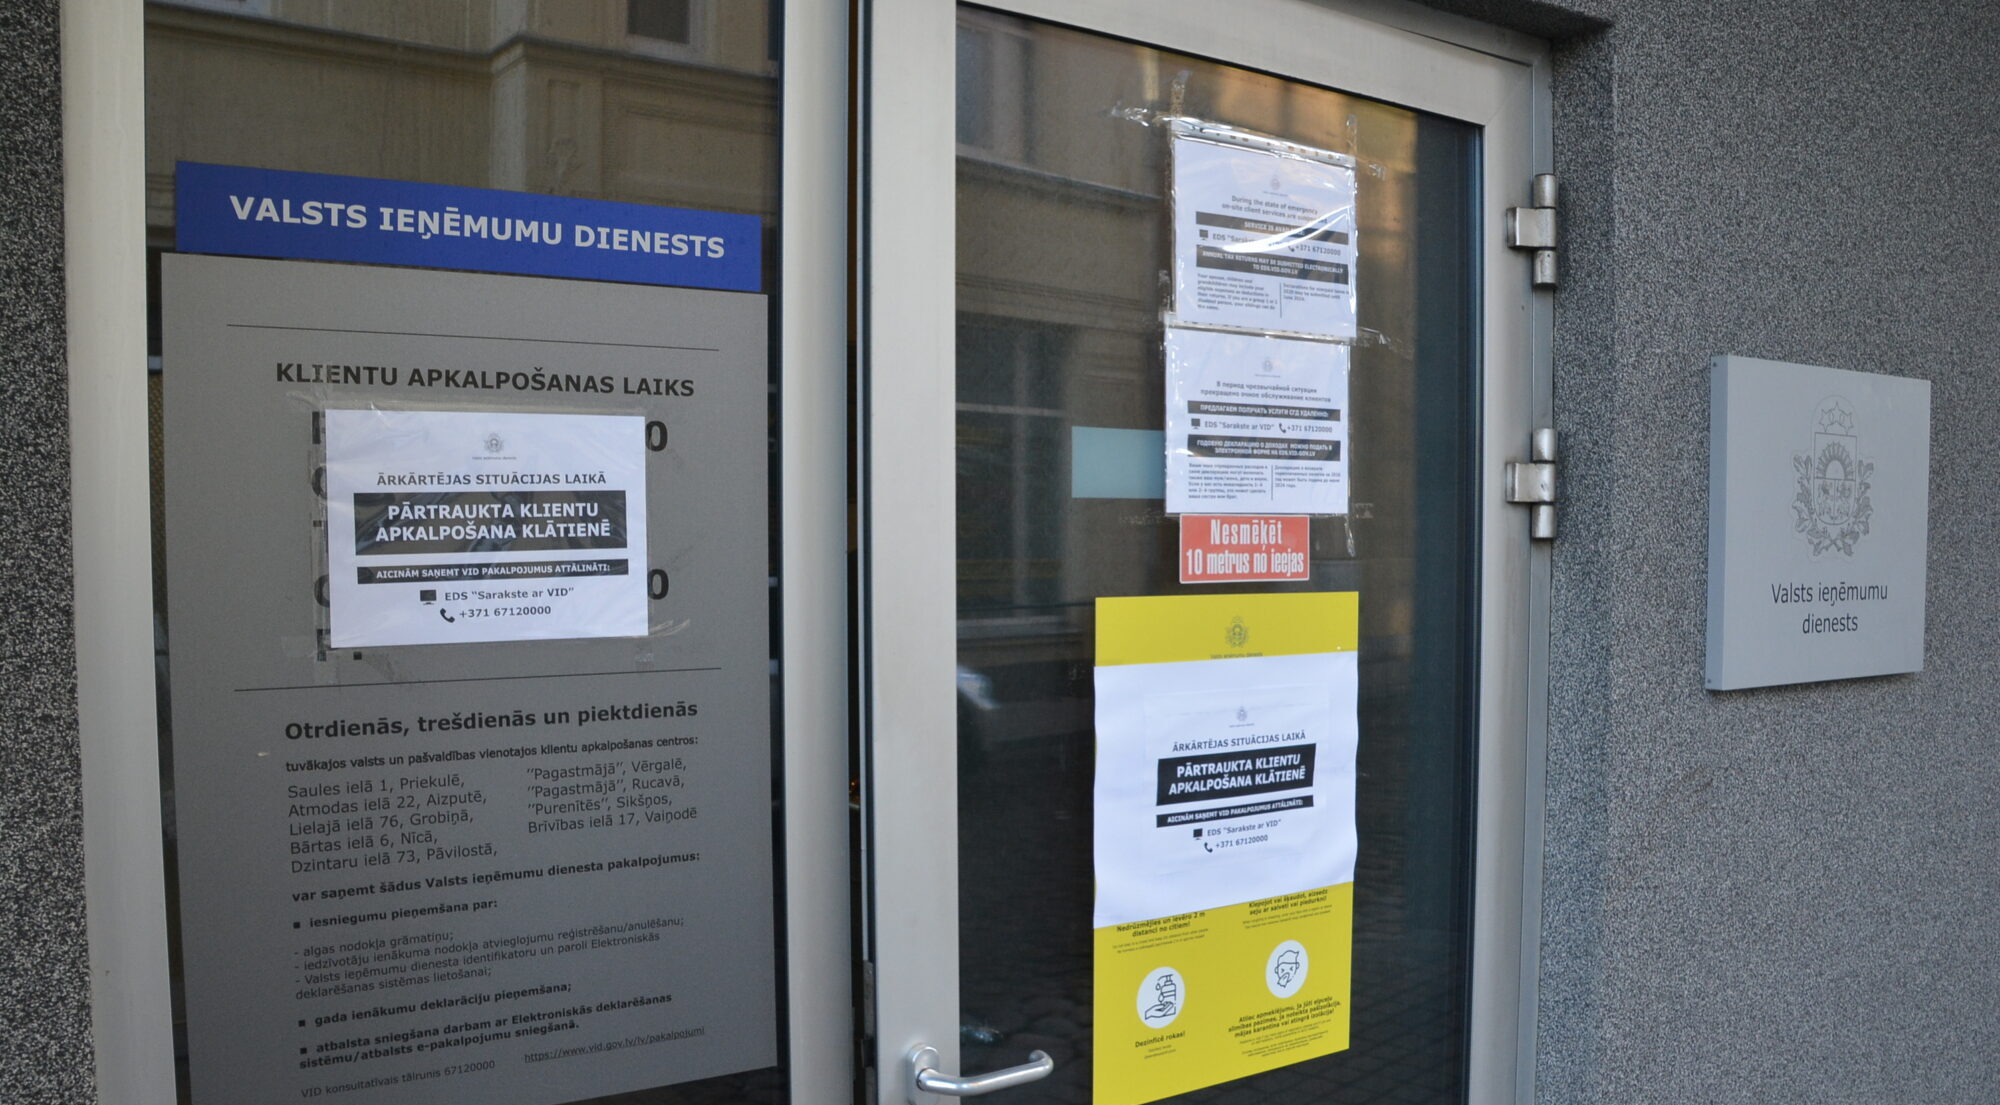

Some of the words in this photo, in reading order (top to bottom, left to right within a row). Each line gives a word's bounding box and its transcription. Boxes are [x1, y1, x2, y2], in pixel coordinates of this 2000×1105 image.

[230, 196, 367, 228] VALSTS
[380, 207, 562, 245] IEŅĒMUMU
[575, 225, 725, 258] DIENESTS
[277, 363, 397, 386] KLIENTU
[408, 367, 614, 393] APKALPOŠANAS
[624, 377, 694, 396] LAIKS
[377, 472, 471, 486] ĀRKĀRTĒJAS
[476, 471, 560, 485] SITUĀCIJAS
[565, 471, 606, 484] LAIKĀ
[388, 502, 514, 520] PĀRTRAUKTA
[520, 503, 598, 517] KLIENTU
[376, 521, 517, 542] APKALPOŠANA
[522, 519, 610, 538] KLĀTIENĒ
[1211, 519, 1282, 550] Nesmēķēt
[376, 568, 419, 578] AICINĀM
[422, 569, 460, 578] SAŅEMT
[462, 568, 479, 576] VID
[482, 565, 552, 575] PAKALPOJUMUS
[555, 563, 610, 573] ATTĀLINĀTI:
[1186, 548, 1203, 575] 10
[1207, 550, 1249, 574] metrus
[1254, 552, 1267, 574] no
[1271, 548, 1304, 577] ieejas
[445, 592, 468, 601] EDS
[532, 590, 543, 598] ar
[1771, 583, 1813, 603] Valsts
[1818, 581, 1888, 607] ieņēmumu
[459, 608, 489, 618] +371
[494, 605, 551, 616] 67120000
[1802, 613, 1858, 634] dienests
[285, 717, 410, 740] Otrdienās,
[418, 710, 536, 732] trešdienās
[544, 711, 570, 724] un
[578, 701, 698, 726] piektdienās
[286, 758, 346, 772] tuvākajos
[350, 755, 385, 767] valsts
[389, 756, 404, 765] un
[408, 751, 475, 767] pašvaldības
[479, 745, 537, 759] vienotajos
[541, 742, 578, 754] klientu
[581, 738, 653, 753] apkalpošanas
[656, 736, 698, 747] centros:
[1172, 737, 1228, 752] ĀRKĀRTĒJAS
[1231, 733, 1279, 747] SITUĀCIJAS
[1282, 730, 1306, 742] LAIKĀ
[631, 758, 687, 774] Vērgalē,
[1177, 759, 1253, 778] PĀRTRAUKTA
[1256, 754, 1300, 768] KLIENTU
[288, 784, 340, 798] Saules
[346, 781, 373, 794] ielā
[380, 779, 393, 793] 1,
[400, 774, 465, 790] Priekulē,
[632, 777, 685, 791] Rucavā,
[1169, 774, 1252, 795] APKALPOŠANA
[1255, 765, 1305, 785] KLĀTIENĒ
[288, 800, 358, 817] Atmodas
[364, 797, 390, 811] ielā
[397, 796, 420, 810] 22,
[426, 790, 487, 808] Aizputē,
[1167, 813, 1193, 823] AICINĀM
[1195, 810, 1217, 821] SAŅEMT
[1219, 809, 1229, 817] VID
[1230, 803, 1271, 815] PAKALPOJUMUS
[1272, 799, 1303, 810] ATTĀLINĀTI:
[289, 818, 341, 836] Lielajā
[347, 817, 373, 831] ielā
[380, 816, 403, 829] 76,
[410, 811, 474, 826] Grobiņā,
[528, 817, 584, 833] Brīvības
[589, 815, 613, 828] ielā
[619, 813, 640, 826] 17,
[645, 807, 697, 824] Vaiņodē
[1207, 828, 1221, 836] EDS
[290, 838, 341, 854] Bārtas
[347, 836, 374, 849] ielā
[380, 835, 394, 848] 6,
[401, 831, 437, 845] Nīcā,
[1215, 840, 1233, 848] +371
[1235, 835, 1268, 846] 67120000
[291, 857, 358, 873] Dzintaru
[364, 853, 390, 867] ielā
[397, 851, 420, 864] 73,
[427, 844, 497, 861] Pāvilostā,
[292, 891, 316, 902] var
[321, 885, 375, 900] saņemt
[379, 880, 421, 894] šādus
[425, 876, 467, 889] Valsts
[473, 870, 543, 885] ieņēmumu
[548, 862, 603, 876] dienesta
[608, 852, 700, 872] pakalpojumus:
[310, 912, 387, 928] iesniegumu
[391, 902, 469, 921] pieņemšana
[473, 900, 498, 912] par:
[303, 945, 335, 958] algas
[340, 938, 386, 952] nodokļa
[390, 931, 453, 948] grāmatiņu;
[304, 954, 369, 971] iedzīvotāju
[373, 948, 430, 962] ienākuma
[434, 942, 478, 955] nodokļa
[483, 934, 554, 950] atvieglojumu
[305, 972, 340, 985] Valsts
[344, 966, 407, 981] ieņēmumu
[411, 957, 459, 970] dienesta
[463, 949, 536, 965] identifikatoru
[541, 947, 554, 956] un
[558, 941, 587, 954] paroli
[591, 932, 660, 949] Elektroniskās
[296, 982, 375, 1000] deklarēšanas
[379, 976, 430, 990] sistēmas
[434, 967, 492, 982] lietošanai;
[315, 1012, 347, 1027] gada
[352, 1004, 416, 1019] ienākumu
[421, 994, 490, 1012] deklarāciju
[494, 983, 572, 1003] pieņemšana;
[316, 1038, 370, 1053] atbalsta
[374, 1028, 439, 1044] sniegšana
[443, 1020, 491, 1035] darbam
[496, 1018, 508, 1027] ar
[512, 1006, 593, 1025] Elektroniskās
[596, 994, 672, 1013] deklarēšanas
[300, 1045, 413, 1069] sistēmu/atbalsts
[417, 1031, 511, 1052] e-pakalpojumu
[515, 1021, 578, 1038] sniegšanā.
[301, 1087, 322, 1098] VID
[326, 1075, 399, 1095] konsultatīvais
[402, 1069, 441, 1083] tālrunis
[444, 1060, 495, 1076] 67120000
